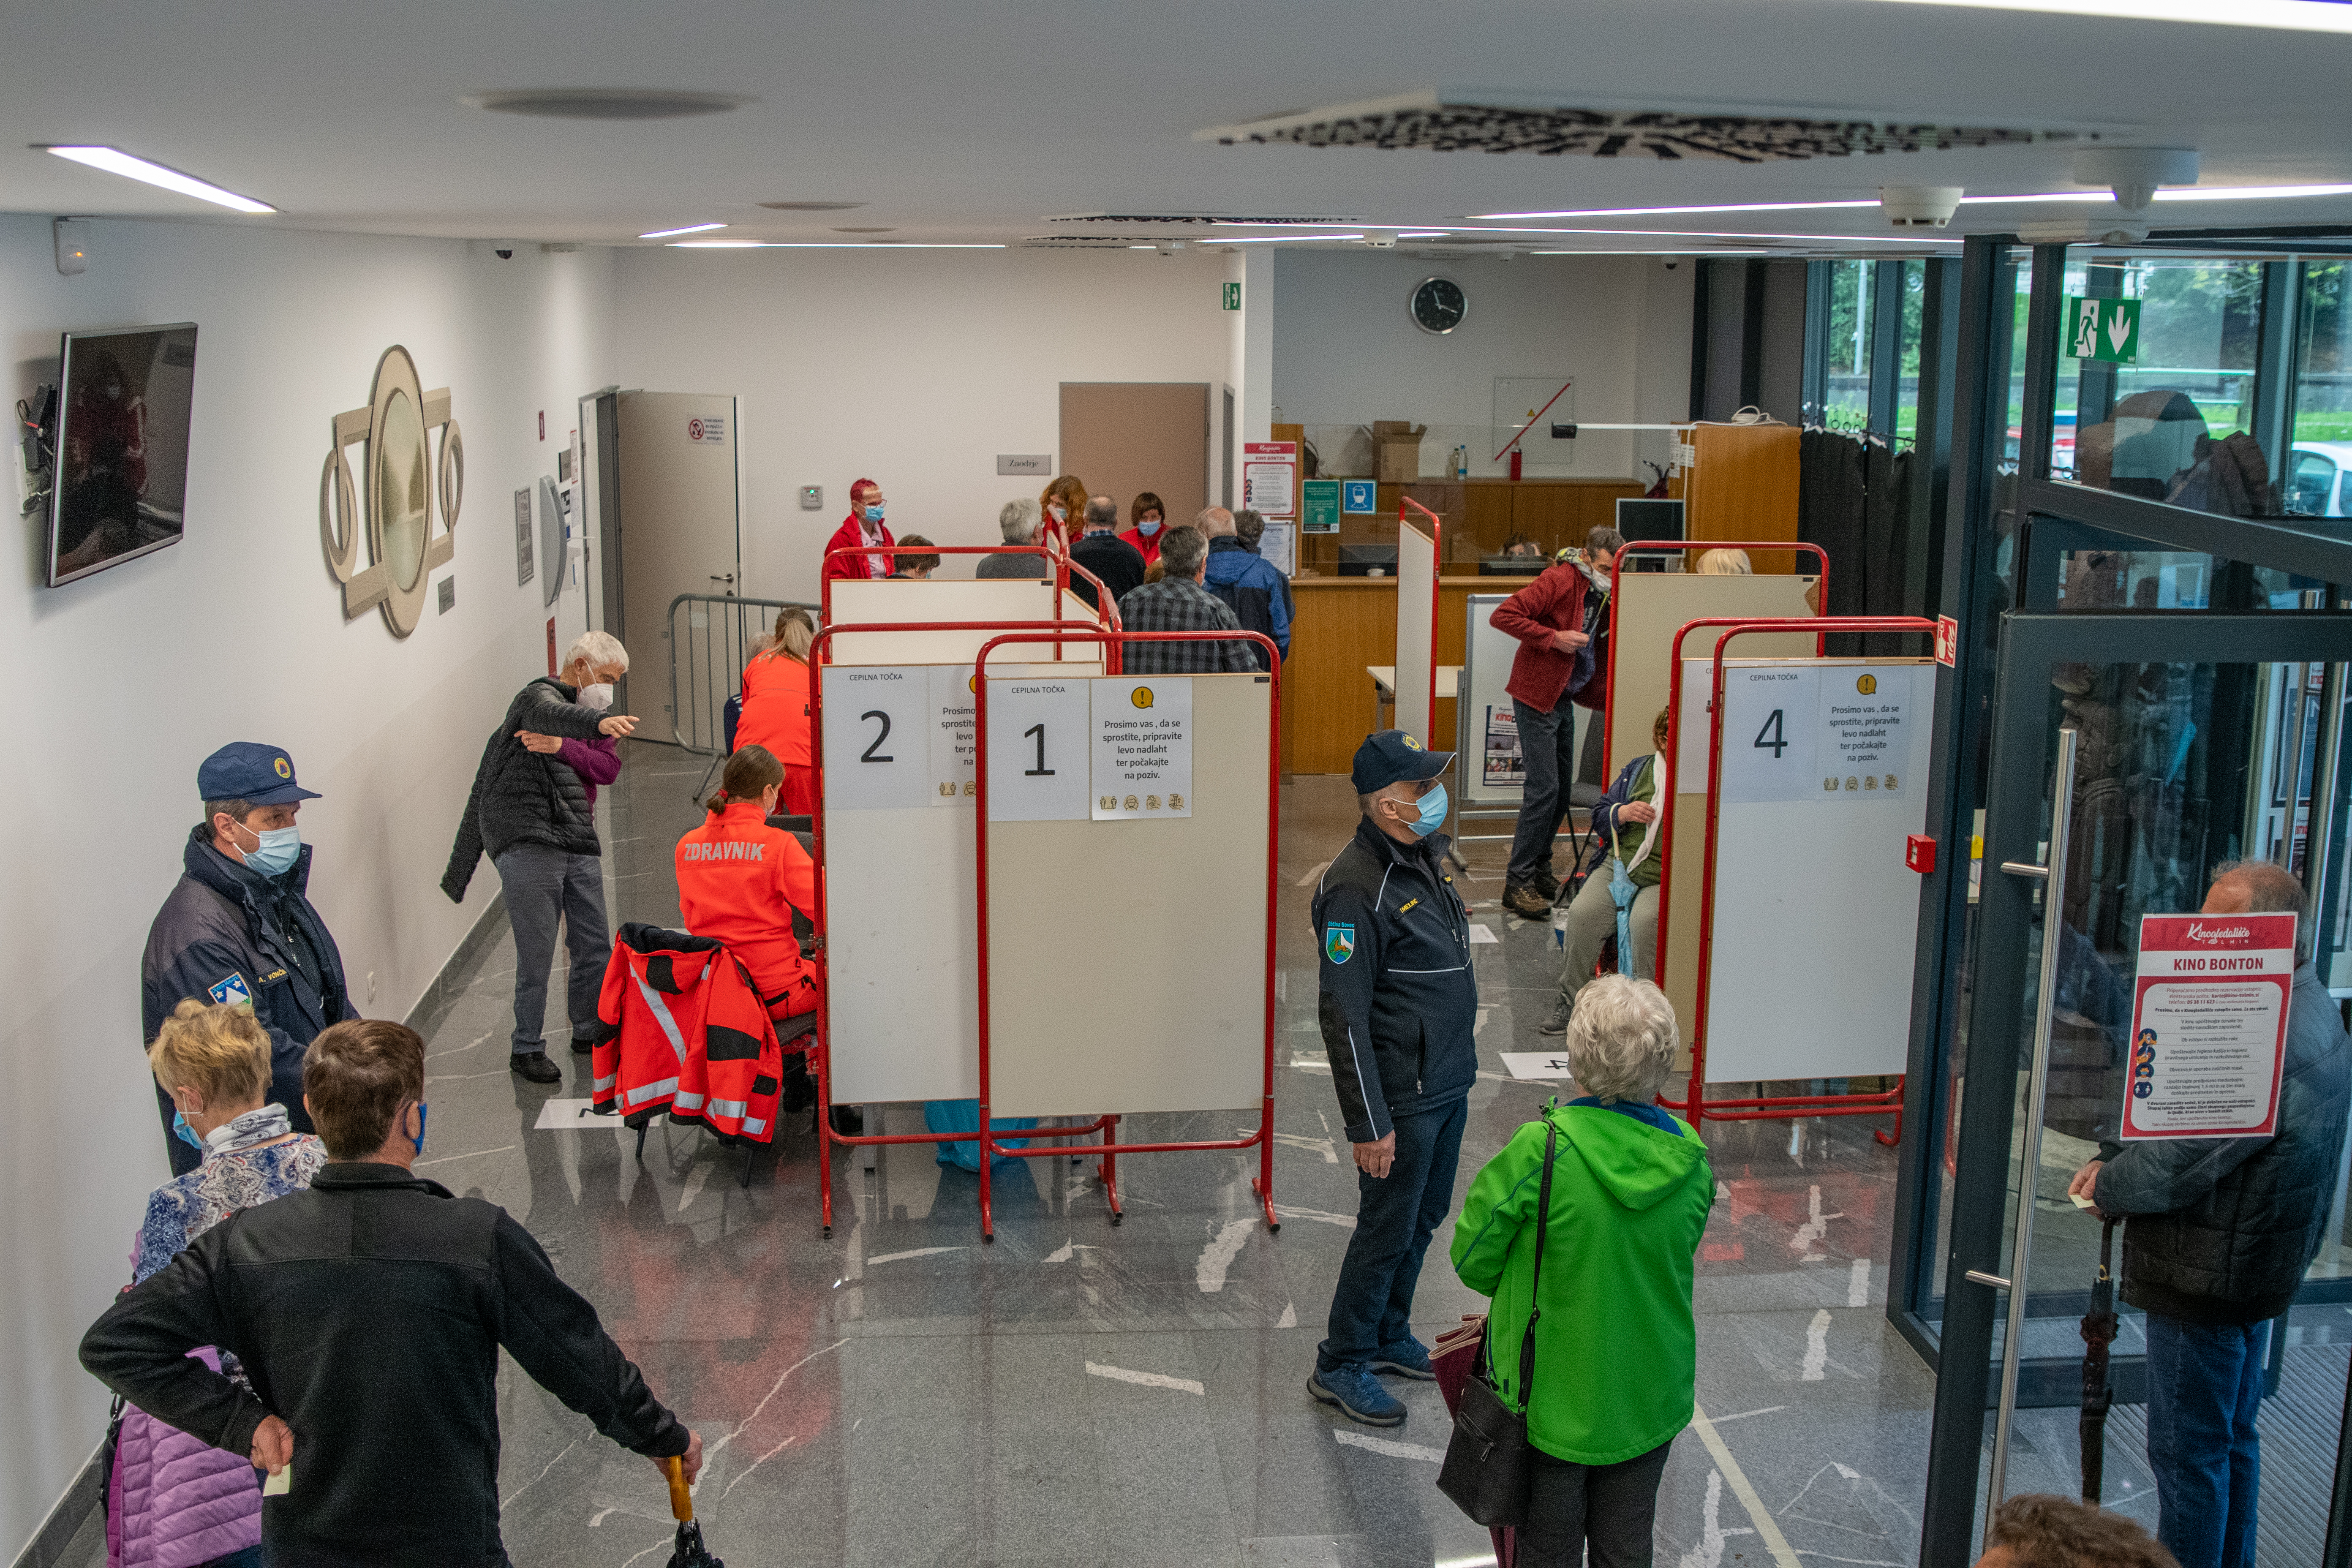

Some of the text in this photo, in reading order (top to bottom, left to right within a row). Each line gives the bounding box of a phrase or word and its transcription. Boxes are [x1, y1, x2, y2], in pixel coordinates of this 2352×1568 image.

[1009, 459, 1039, 468] Zaodrje
[943, 707, 976, 715] Prosimo
[1832, 706, 1862, 714] Prosimo
[1881, 705, 1889, 713] da
[1104, 720, 1138, 728] Prosimo
[1160, 719, 1170, 727] da
[1829, 717, 1900, 727] sprostite, pripravite
[861, 710, 894, 763] 2
[956, 732, 973, 740] levo
[1103, 732, 1182, 743] sprostite, pripravite
[1754, 709, 1788, 758] 4
[1859, 729, 1886, 737] nadlaht
[1024, 724, 1056, 776] 1
[1118, 745, 1168, 754] levo nadlaht
[1852, 741, 1887, 751] počakajte
[1130, 758, 1169, 768] počakajte
[1858, 753, 1878, 763] poziv.
[1137, 771, 1160, 781] poziv.
[684, 842, 766, 861] ZDRAVNIK
[2174, 958, 2263, 971] KINO BONTON
